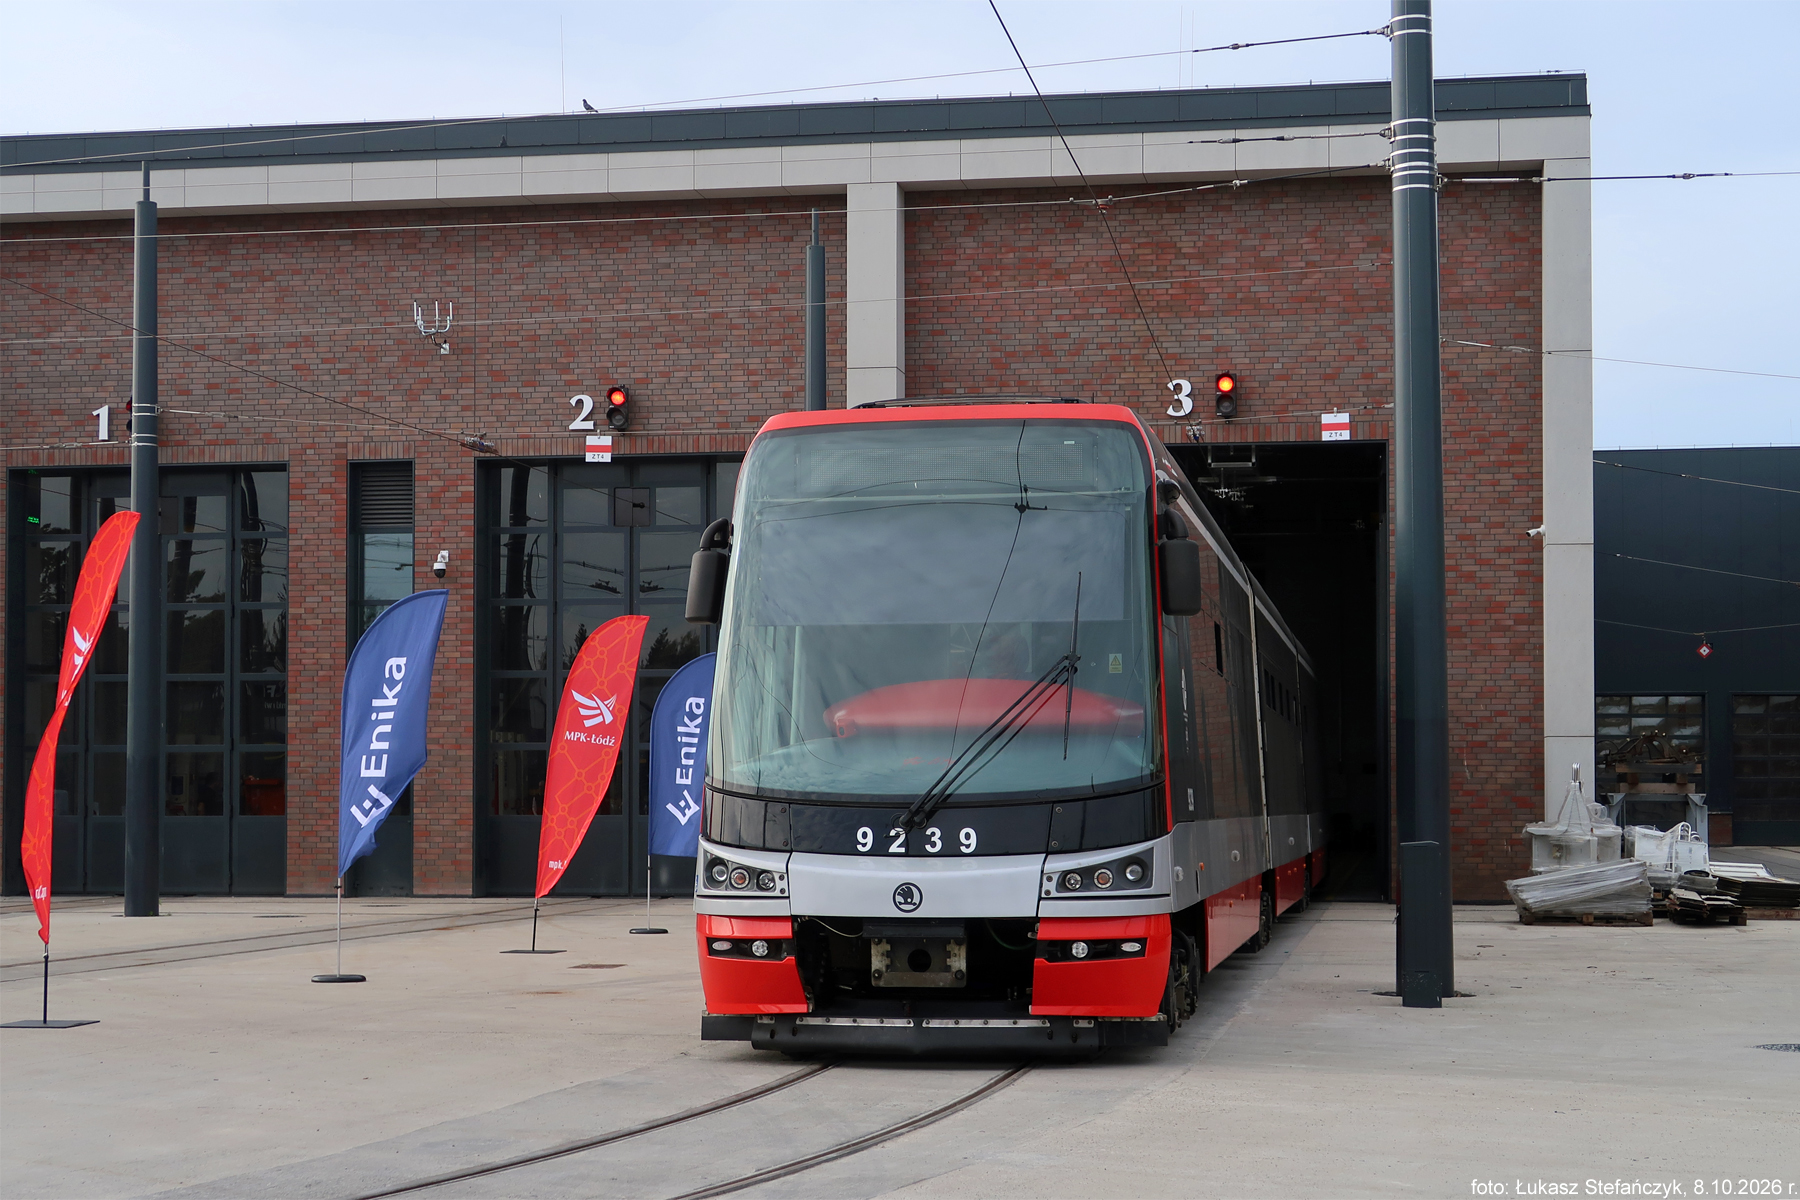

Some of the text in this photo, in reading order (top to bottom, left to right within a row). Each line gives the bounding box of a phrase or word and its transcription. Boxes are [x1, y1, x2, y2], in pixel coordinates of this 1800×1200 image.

[569, 394, 594, 430] 2
[1166, 379, 1193, 417] 3
[92, 404, 108, 440] 1
[360, 656, 407, 778] Enika
[564, 730, 616, 747] MPK-Łódź
[675, 696, 706, 785] Enika
[856, 826, 977, 854] 9239
